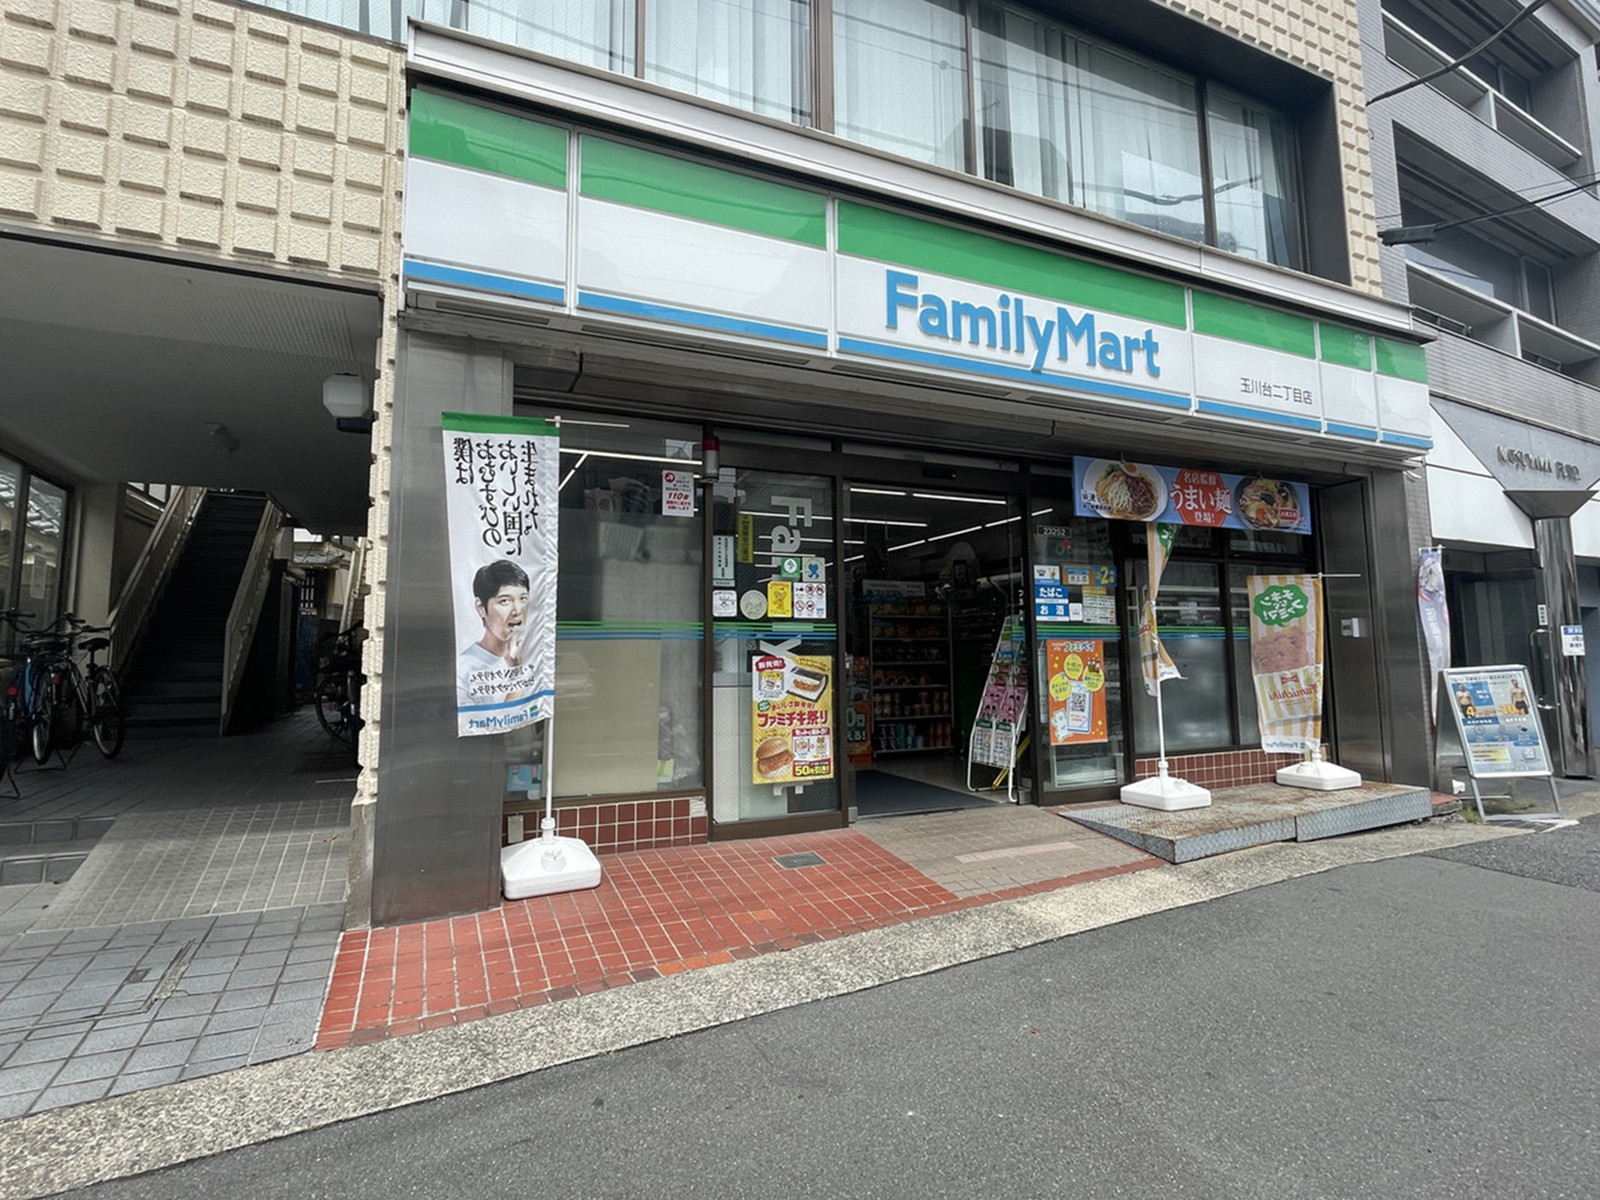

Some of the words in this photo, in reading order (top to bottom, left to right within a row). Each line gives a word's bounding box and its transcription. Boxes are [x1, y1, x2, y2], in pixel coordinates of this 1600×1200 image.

[885, 269, 1162, 378] FamilyMart
[1239, 376, 1313, 406] 玉川台二丁目店
[1169, 483, 1233, 515] うまい麺
[1038, 586, 1064, 598] たばこ
[757, 710, 829, 728] ファミチキ祭り
